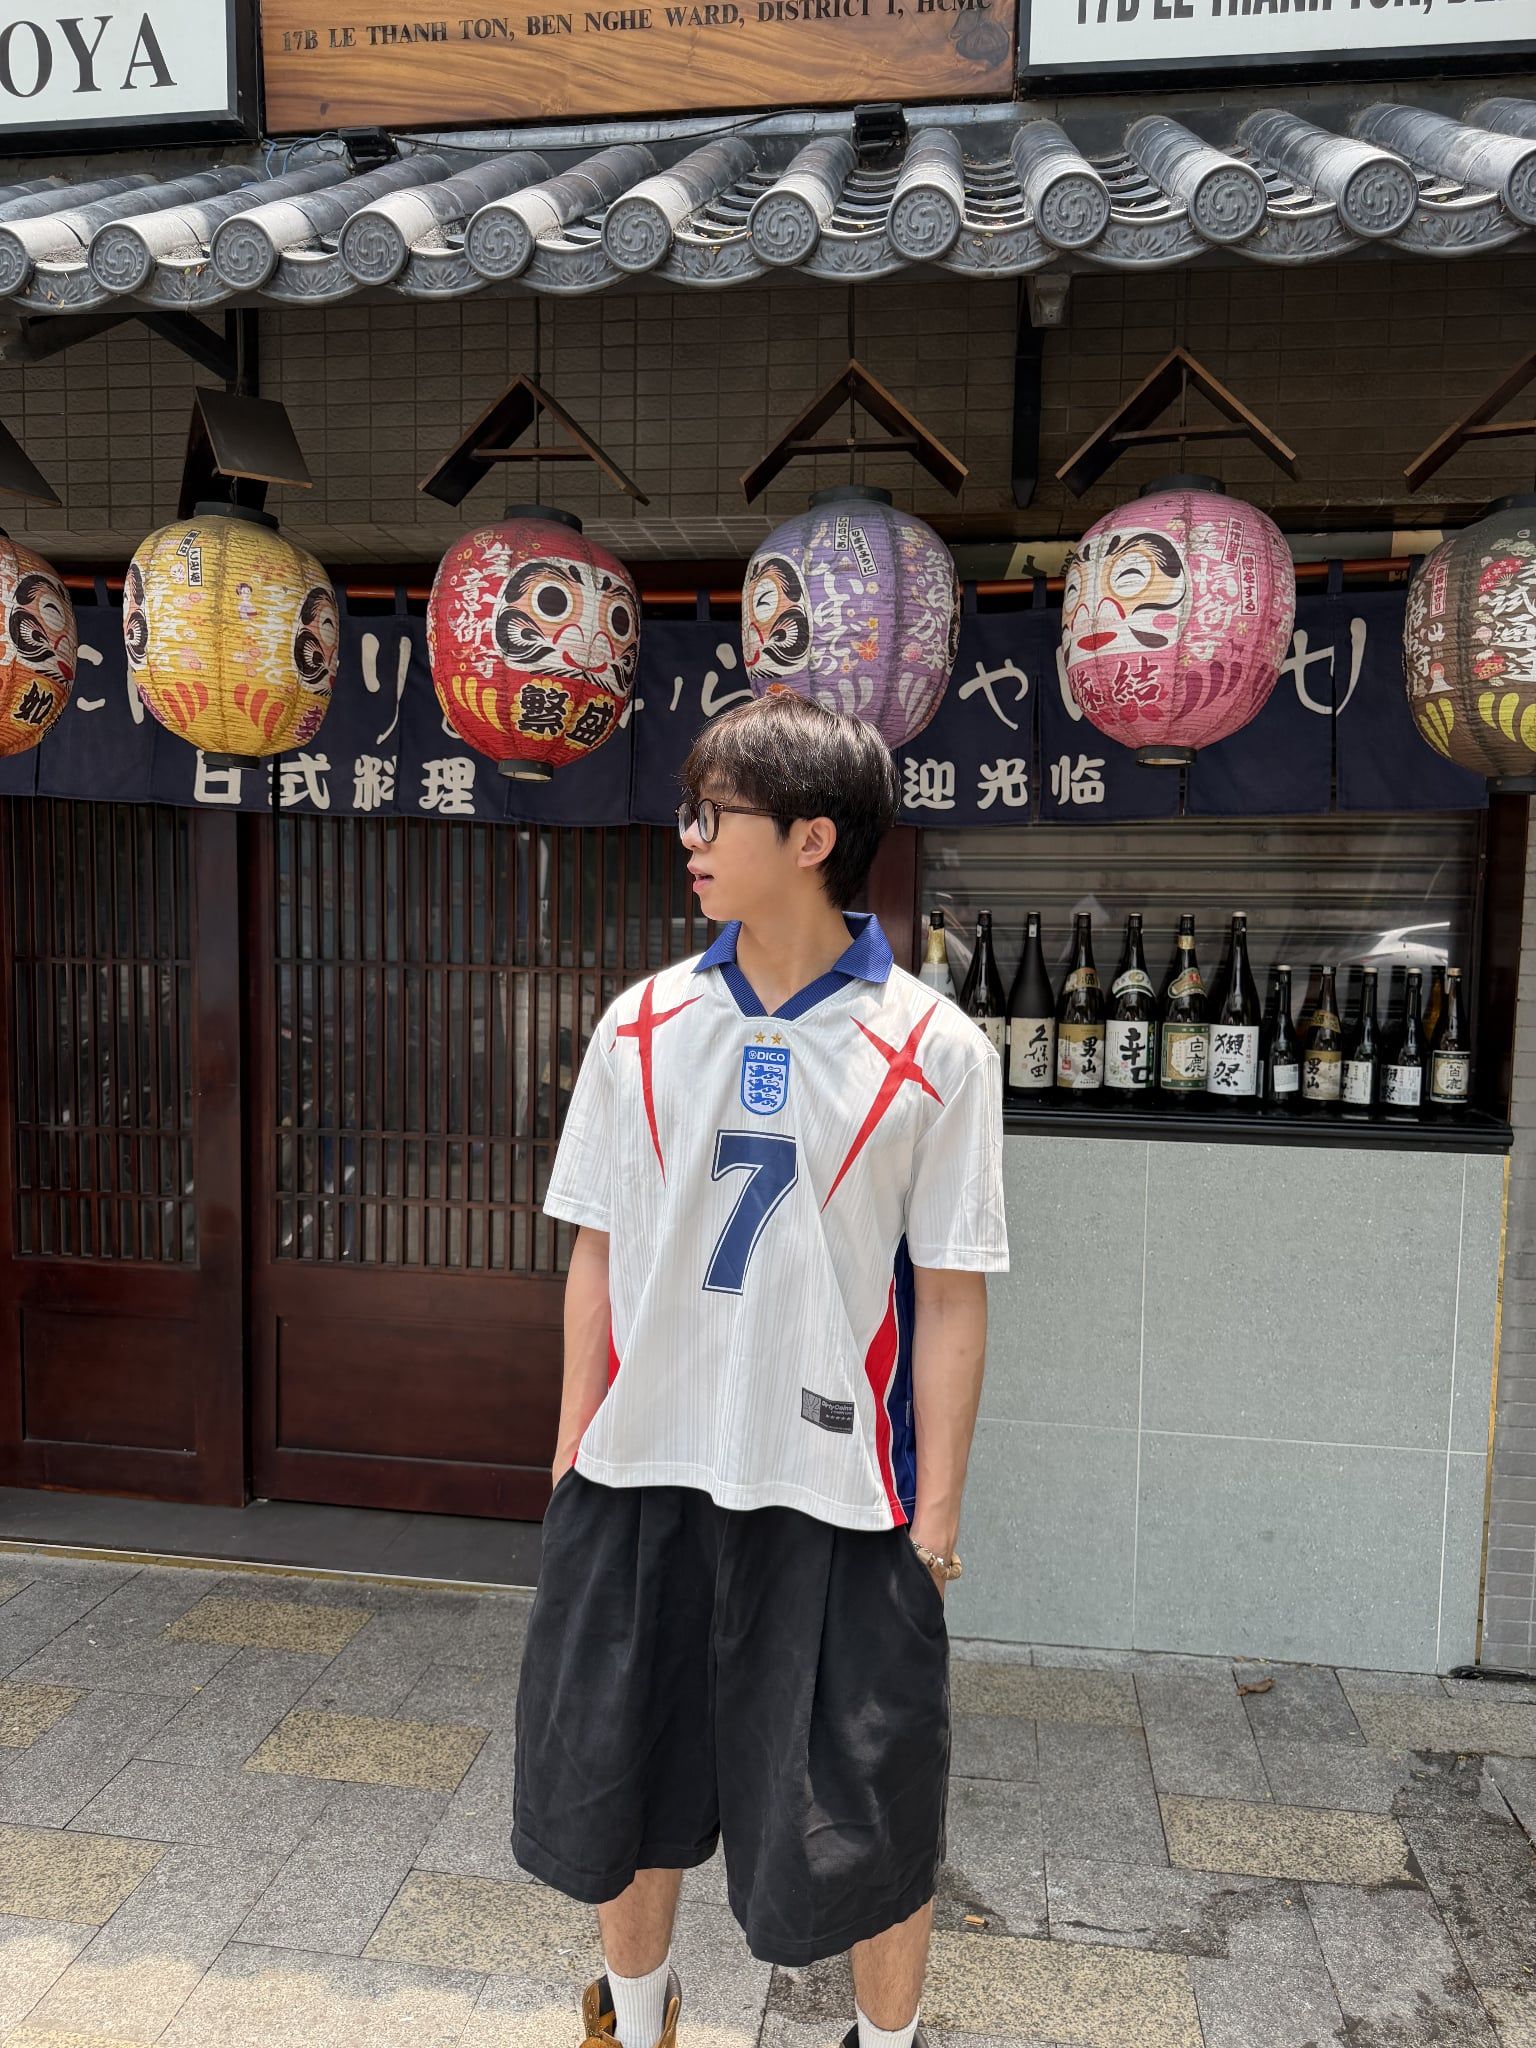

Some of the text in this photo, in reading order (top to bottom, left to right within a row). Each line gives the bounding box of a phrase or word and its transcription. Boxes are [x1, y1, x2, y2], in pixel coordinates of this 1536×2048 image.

[282, 31, 319, 51] 17B
[328, 27, 356, 48] LE
[366, 21, 448, 46] THANH
[459, 17, 515, 42] TON,
[526, 13, 573, 36] BEN
[584, 8, 653, 33] NGHE
[664, 3, 746, 30] WARD,
[756, 0, 870, 23] DISTRICT
[0, 13, 177, 98] OYA
[757, 1051, 786, 1063] DICO
[1081, 1036, 1098, 1075] 男山
[701, 1129, 798, 1296] 7
